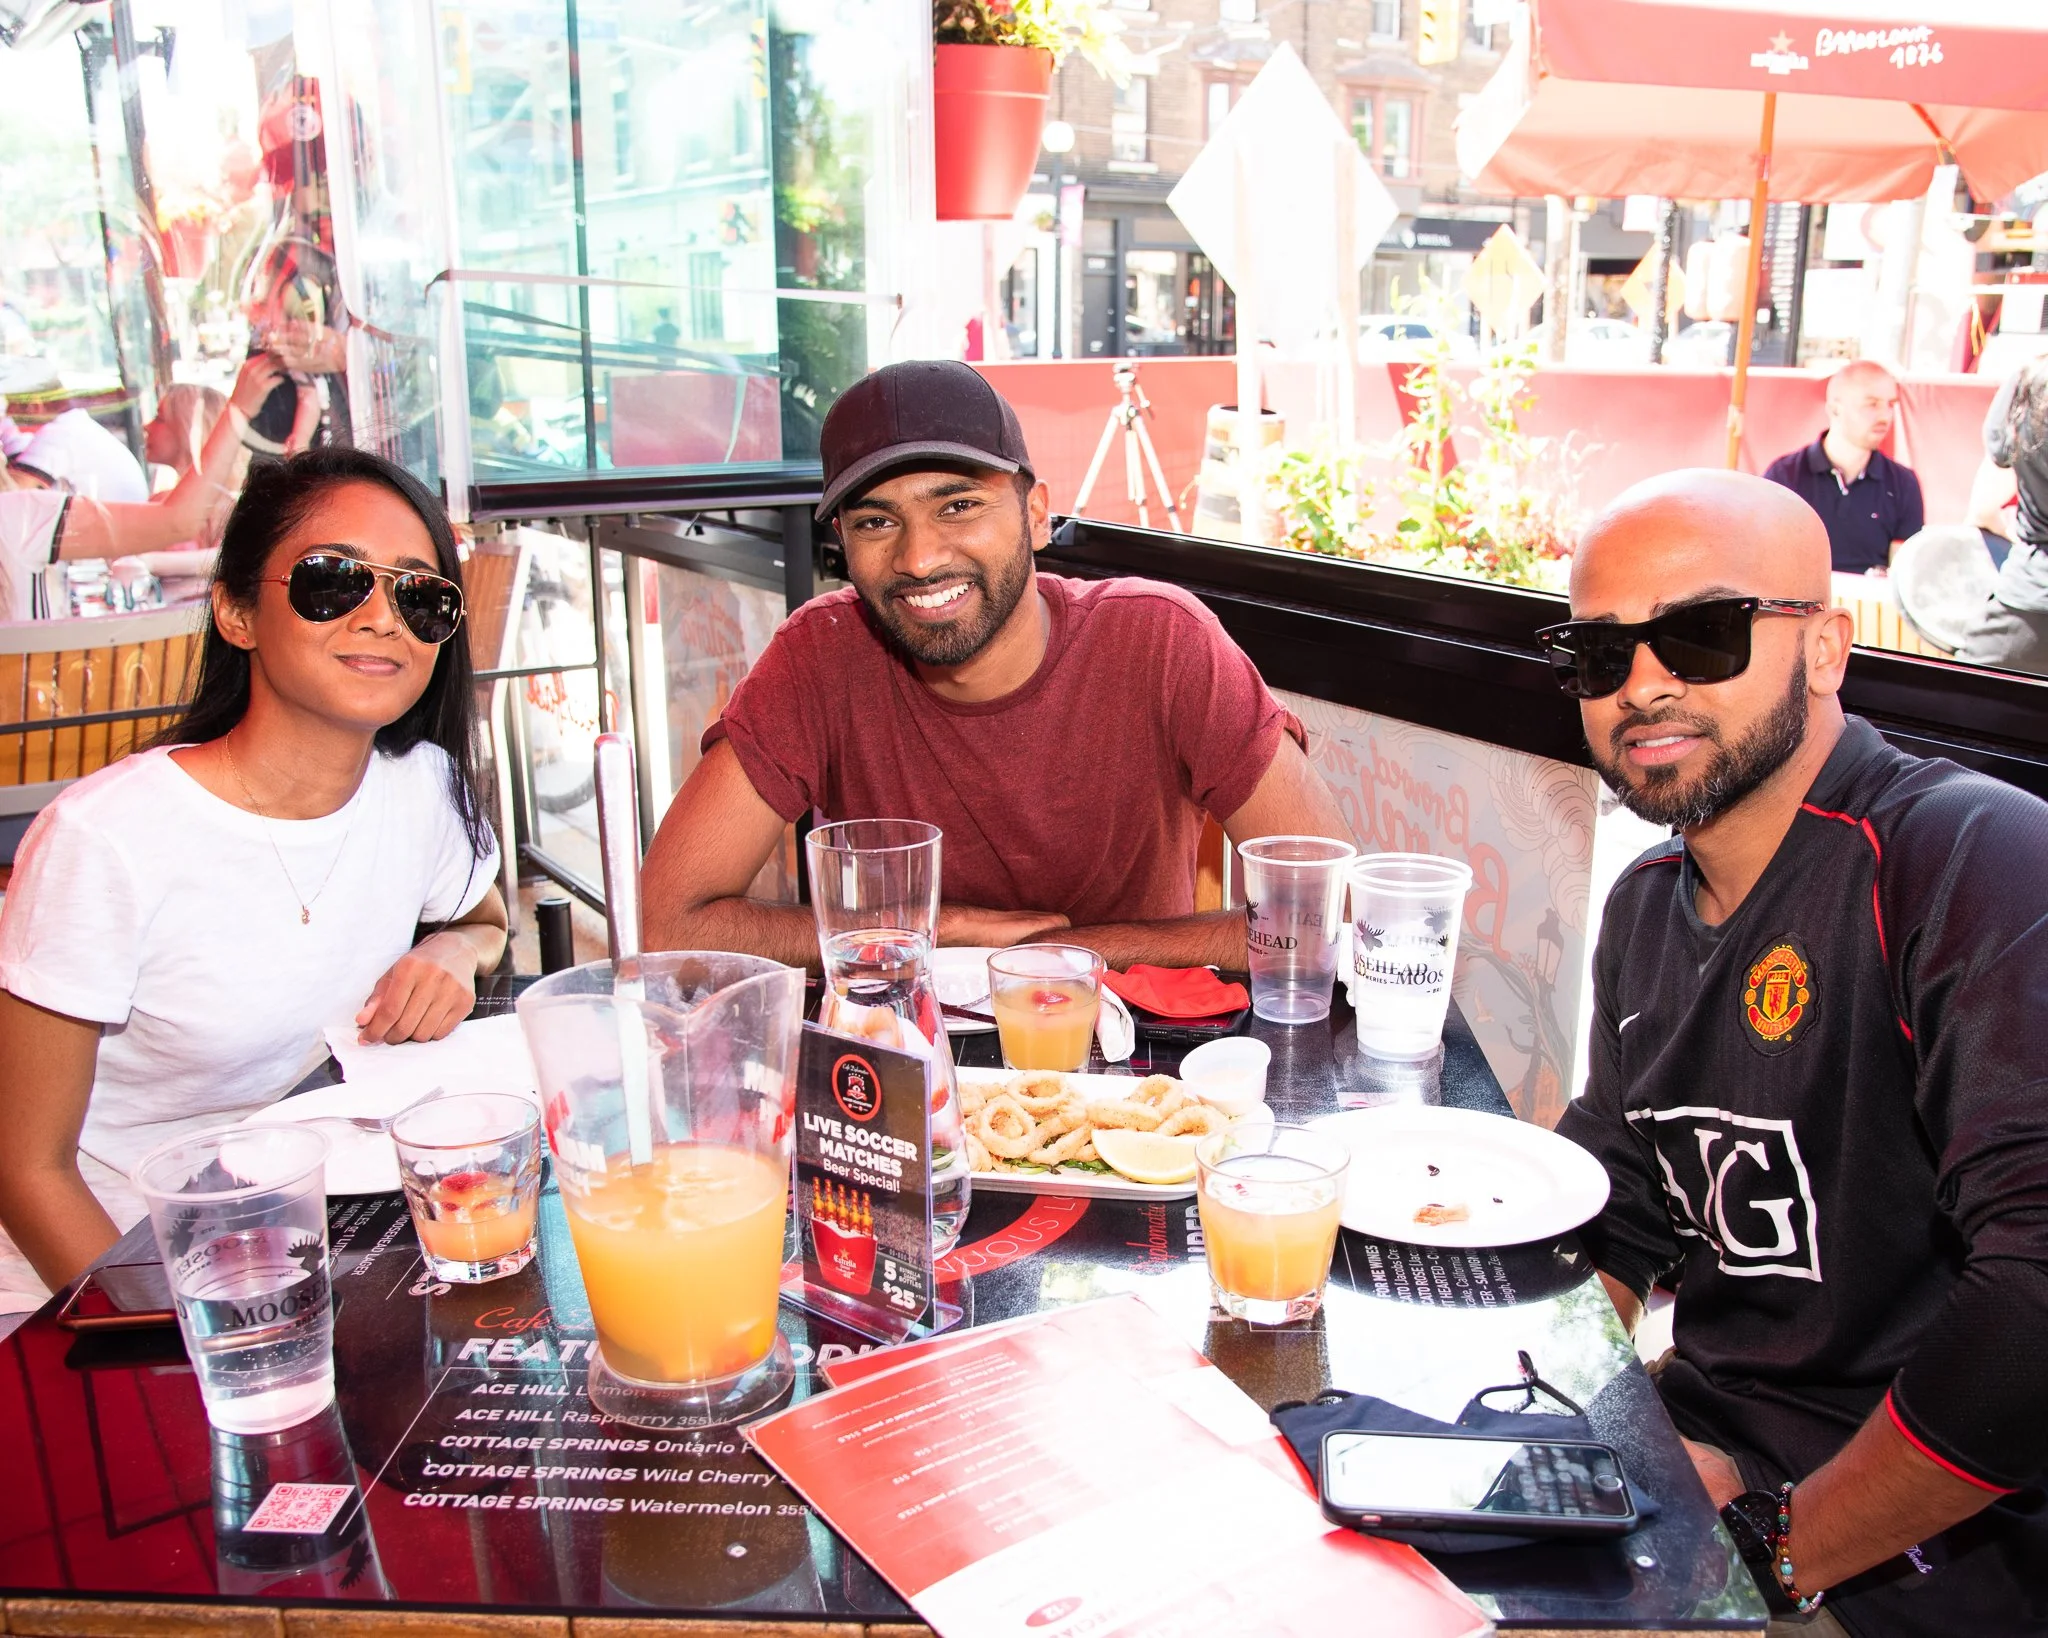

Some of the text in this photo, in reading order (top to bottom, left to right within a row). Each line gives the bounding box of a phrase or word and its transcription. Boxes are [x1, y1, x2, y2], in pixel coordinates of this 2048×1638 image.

[1756, 1017, 1790, 1034] UNITED
[804, 1112, 918, 1162] LIVE SOCCER
[819, 1137, 903, 1178] MATCHES
[823, 1158, 901, 1194] Beer Special!
[351, 1253, 380, 1277] LAGER
[1365, 1245, 1384, 1269] WINES
[883, 1259, 897, 1281] 5
[1372, 1269, 1388, 1283] ME
[1411, 1267, 1427, 1287] ROSE
[899, 1276, 922, 1289] BOTTLES
[1431, 1266, 1453, 1300] HEARTED
[882, 1281, 916, 1310] $25
[471, 1383, 519, 1395] ACE
[520, 1384, 570, 1396] HILL
[455, 1408, 504, 1421] ACE
[505, 1409, 556, 1422] HILL
[561, 1411, 673, 1426] Raspberry
[440, 1435, 545, 1449] COTTAGE
[546, 1437, 650, 1452] SPRINGS
[654, 1439, 736, 1454] Ontario
[422, 1463, 777, 1487] COTTAGE SPRINGS Wild Cherry
[404, 1493, 512, 1509] COTTAGE
[515, 1495, 625, 1511] SPRINGS
[630, 1498, 771, 1516] Watermelon
